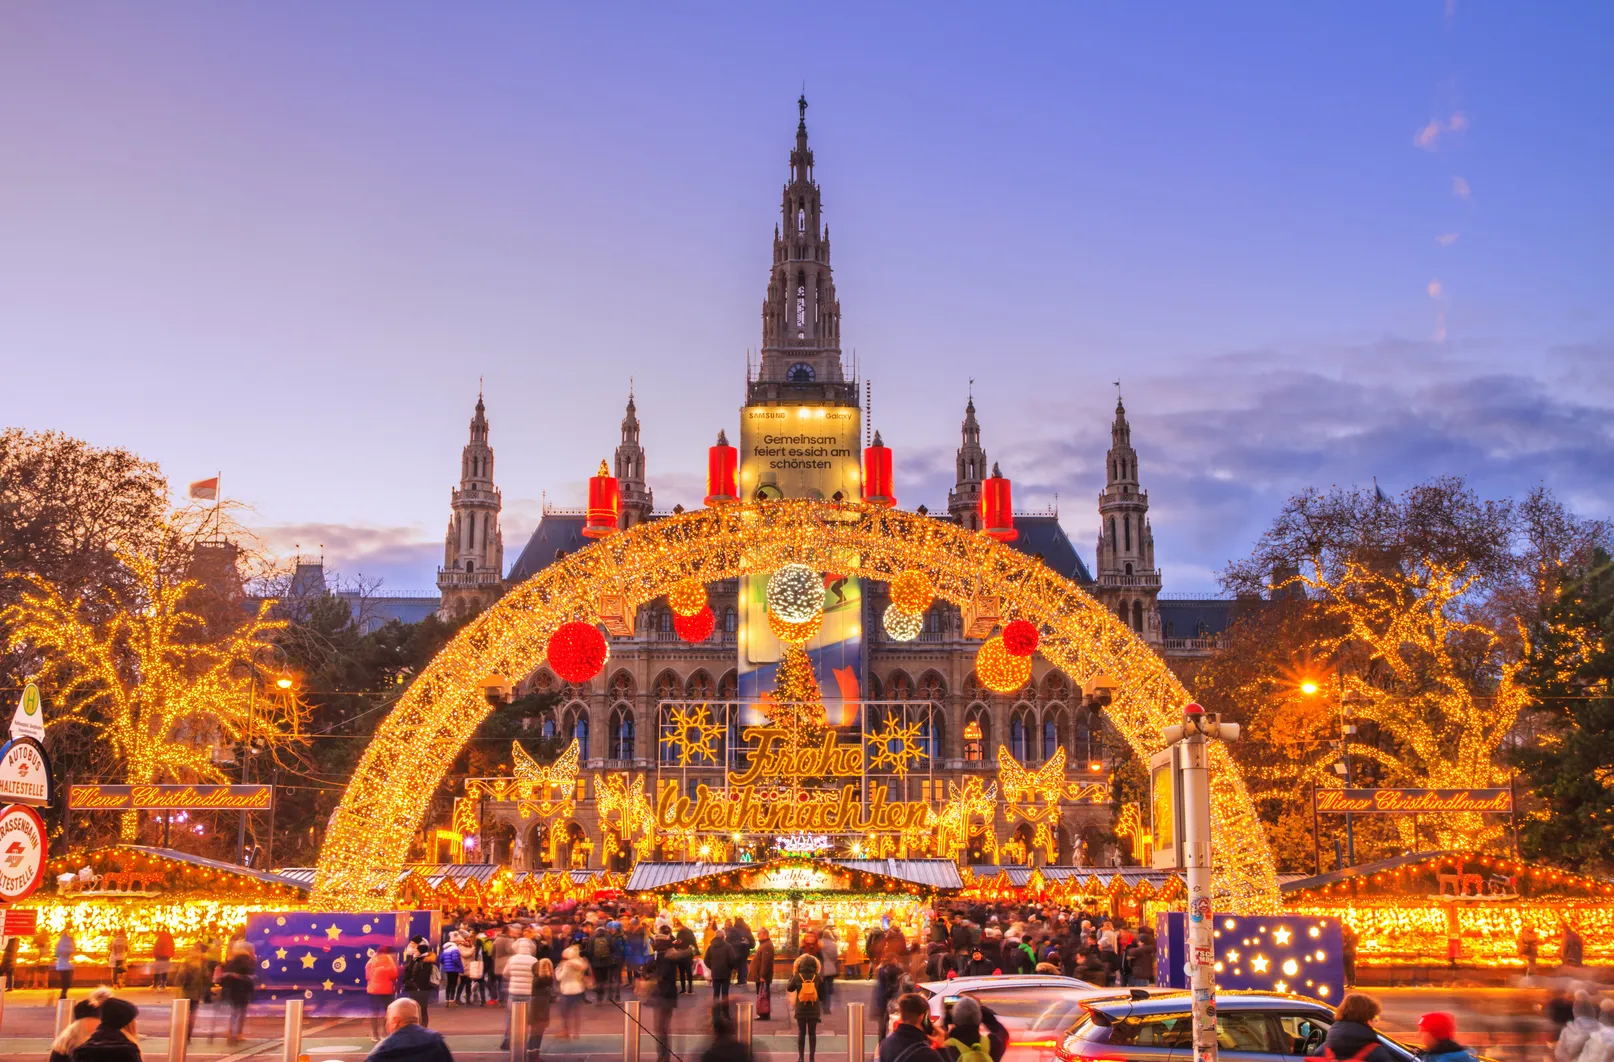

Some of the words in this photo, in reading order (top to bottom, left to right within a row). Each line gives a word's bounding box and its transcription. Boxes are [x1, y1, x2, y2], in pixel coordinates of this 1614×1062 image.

[825, 412, 853, 420] Galaxy
[763, 433, 837, 445] Gemeinsam
[753, 446, 786, 457] feiert
[788, 448, 804, 457] es
[805, 446, 828, 457] sich
[830, 448, 851, 457] am
[769, 459, 832, 470] schönsten
[8, 746, 42, 772] AUTOBUS
[727, 728, 865, 786] Frohe
[0, 779, 44, 797] HALTESTELLE
[71, 787, 129, 808] Wiener
[131, 786, 271, 808] Christkindlmarkt
[656, 784, 932, 832] Weihnachten
[1317, 790, 1373, 811] Wiener
[1374, 790, 1511, 811] Christkindlmarkt
